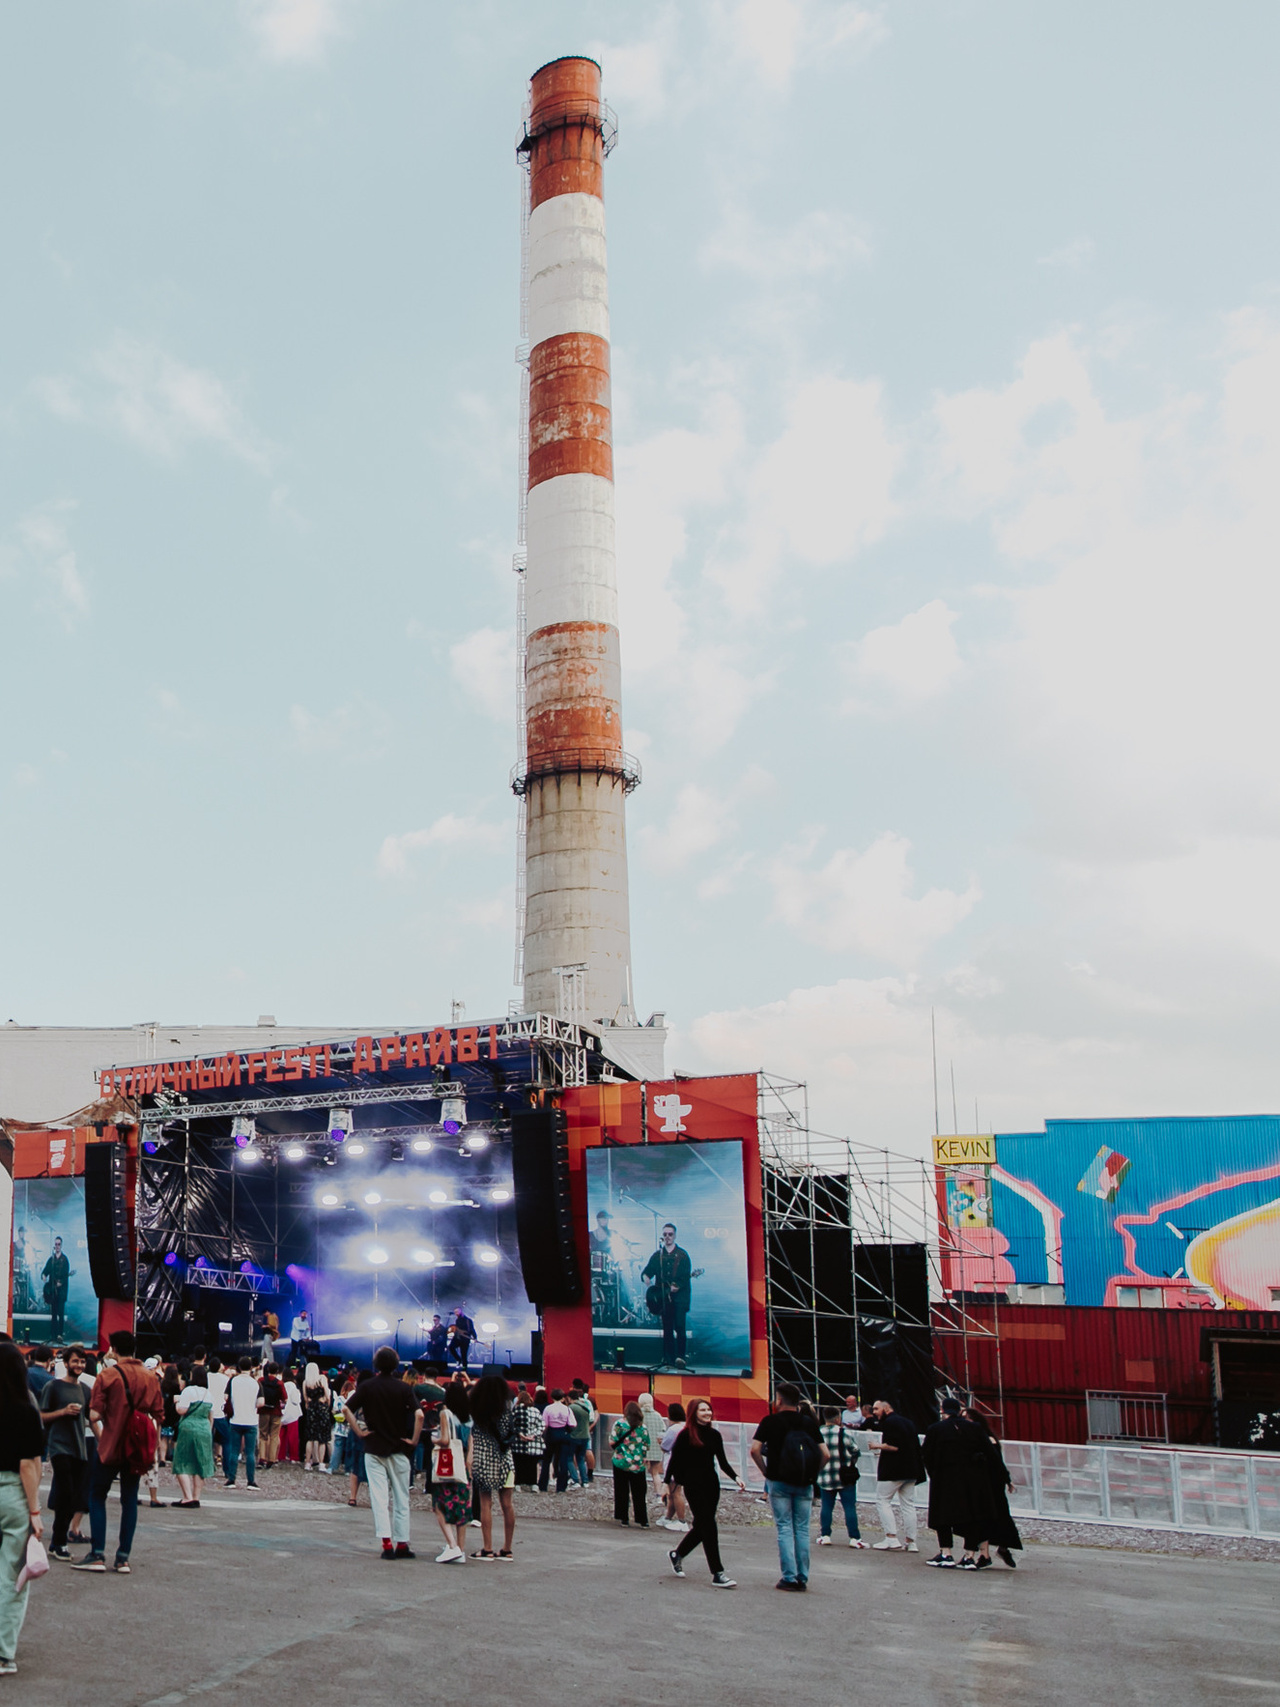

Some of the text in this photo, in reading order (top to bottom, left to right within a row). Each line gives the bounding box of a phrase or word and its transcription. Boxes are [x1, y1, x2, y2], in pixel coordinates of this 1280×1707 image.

[100, 1051, 241, 1098] ОТЛИЧНЫЙ
[352, 1027, 479, 1074] ДРАЙВ
[936, 1139, 990, 1159] KEVIN
